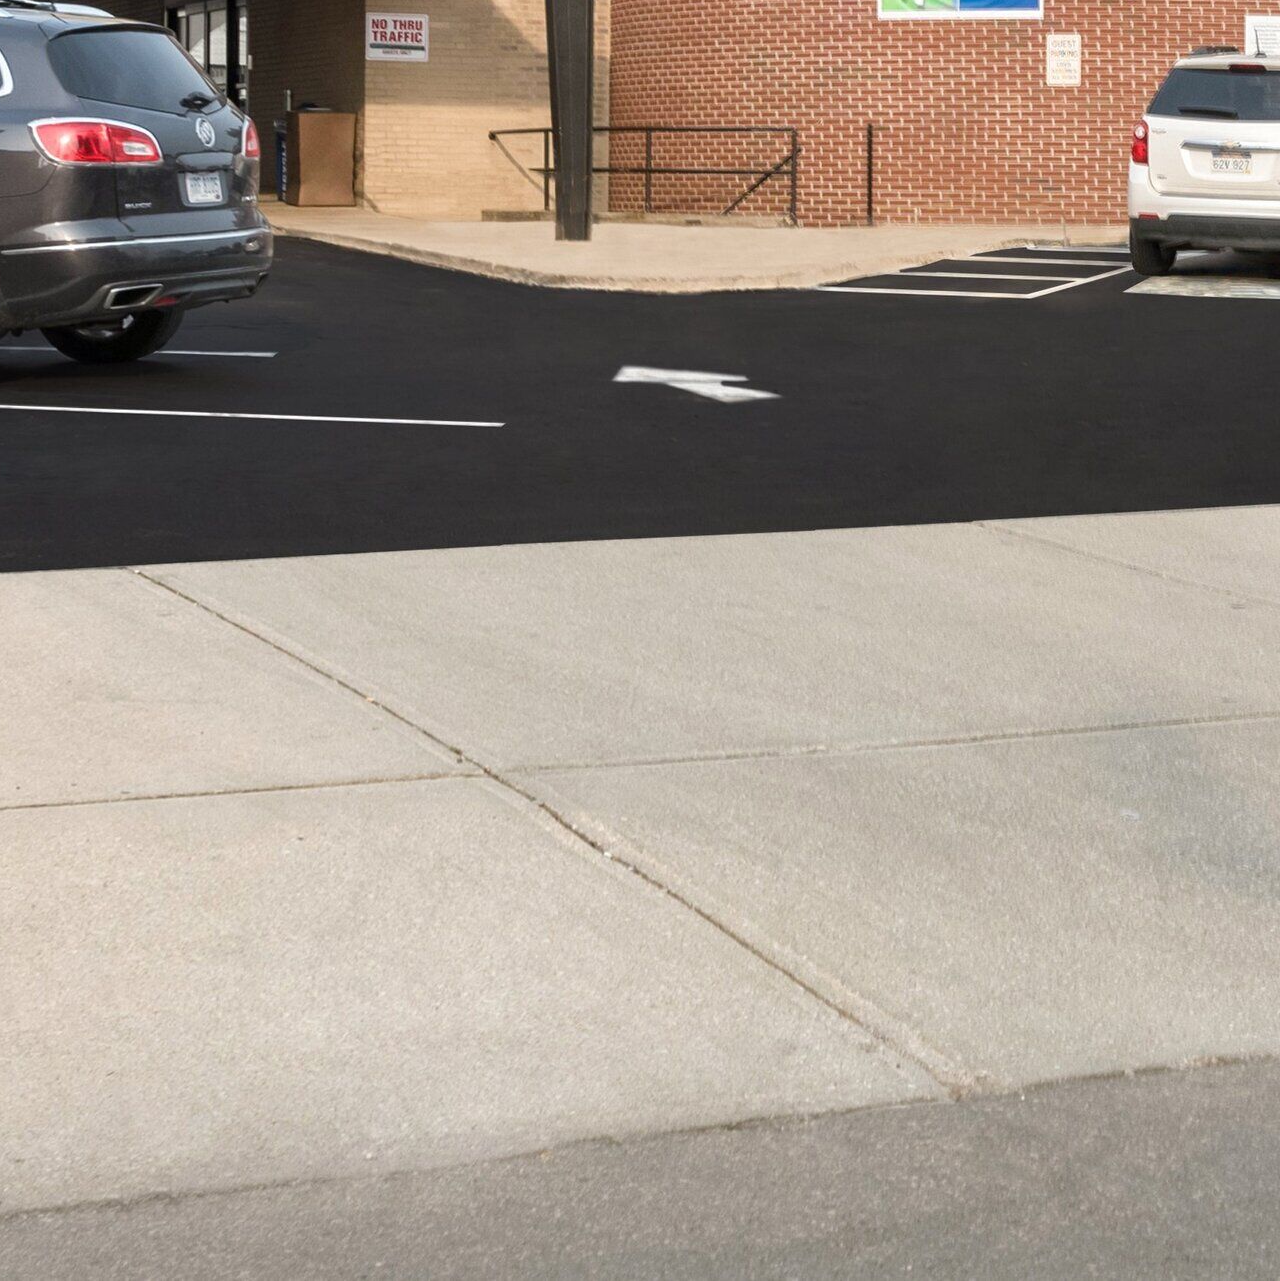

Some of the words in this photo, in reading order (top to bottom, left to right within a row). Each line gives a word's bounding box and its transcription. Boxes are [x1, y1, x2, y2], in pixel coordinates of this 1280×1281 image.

[371, 19, 387, 29] NO
[392, 20, 423, 31] THRU
[371, 30, 423, 43] TRAFFIC
